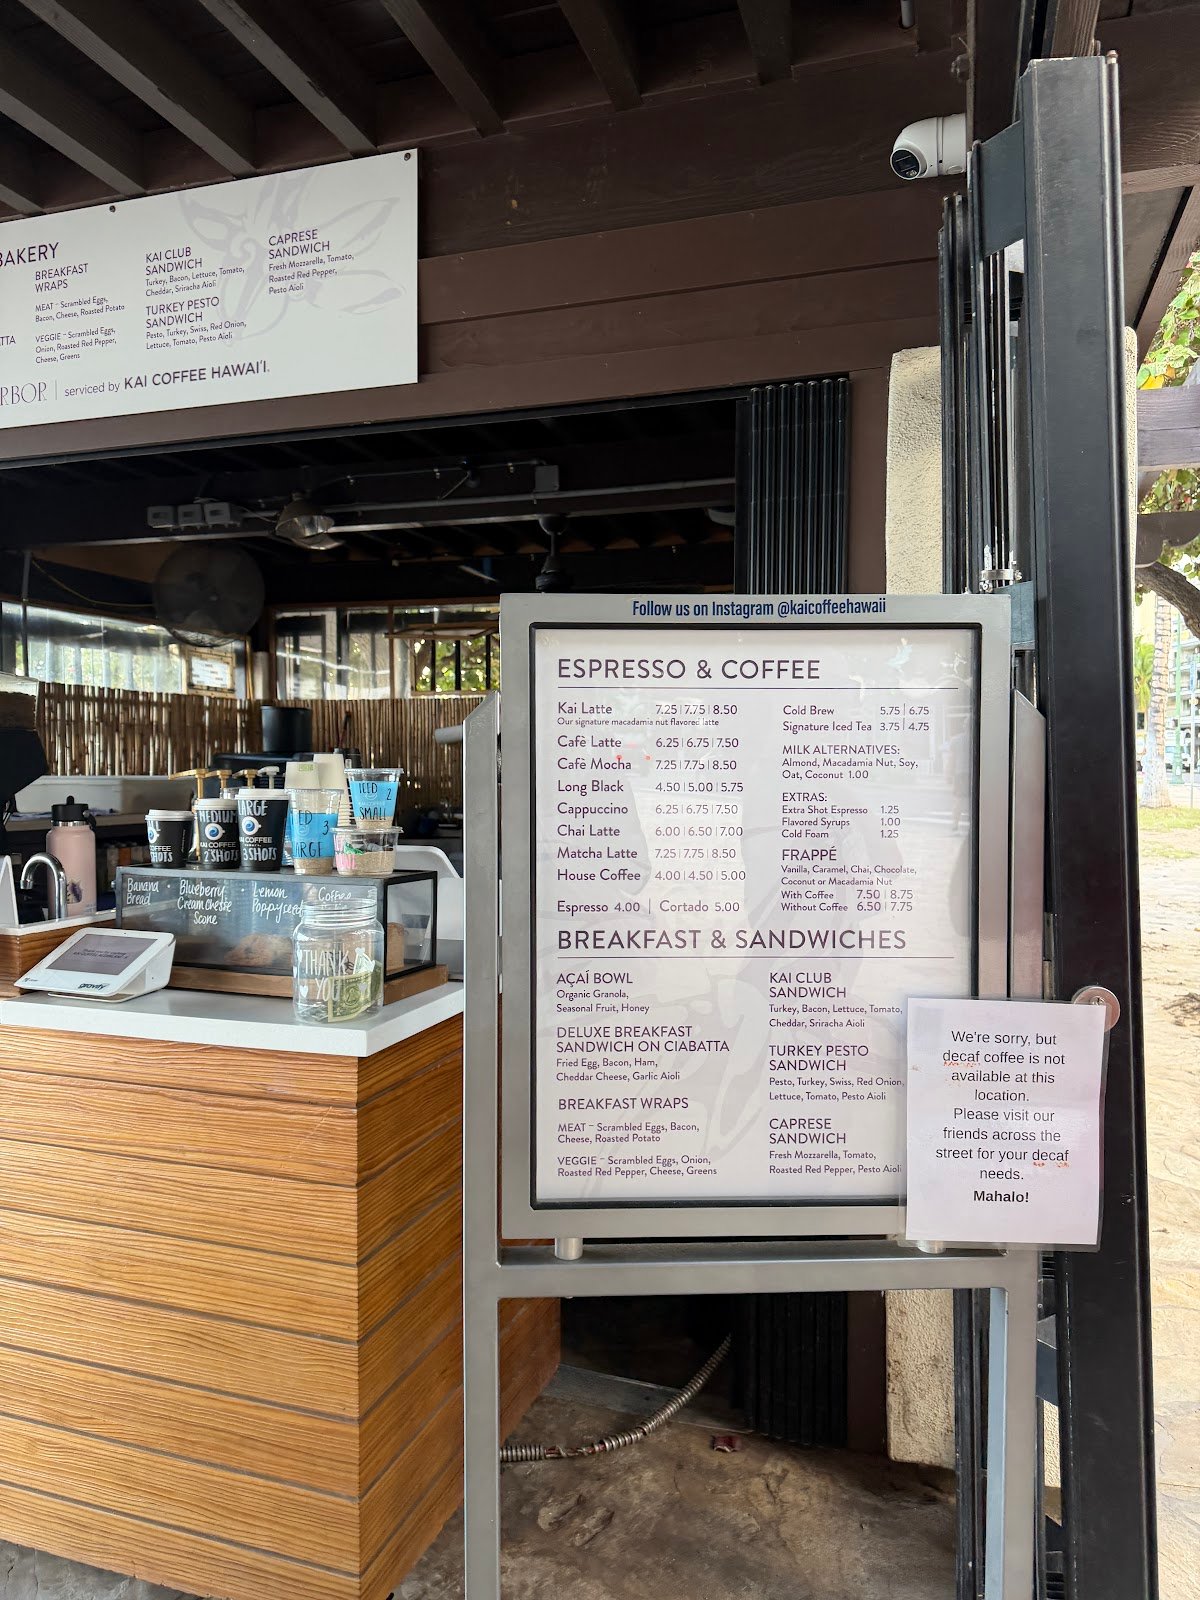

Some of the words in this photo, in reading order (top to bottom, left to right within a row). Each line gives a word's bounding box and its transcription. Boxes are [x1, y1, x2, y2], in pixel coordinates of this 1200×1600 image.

[269, 229, 318, 246] CAPRESE
[146, 252, 162, 263] KAI
[165, 247, 191, 259] CLUB
[269, 241, 330, 259] SANDWICH
[146, 258, 202, 275] SANDWICH
[269, 262, 287, 271] Fresh
[289, 257, 325, 268] Mozzarella,
[327, 254, 354, 262] Tomato,
[36, 263, 88, 280] BREAKFAST
[146, 278, 168, 286] Turkey,
[220, 267, 244, 275] Tomato,
[35, 279, 68, 292] WRAPS
[146, 287, 174, 296] Cheddar,
[175, 283, 200, 292] Sriracha
[202, 280, 216, 288] Aioli
[288, 283, 304, 291] Aioli
[146, 301, 184, 315] TURKEY
[188, 297, 219, 310] PESTO
[146, 312, 202, 328] SANDWICH
[64, 382, 105, 397] serviced
[108, 382, 120, 392] by
[125, 375, 146, 389] KAI
[152, 368, 206, 385] COFFEE
[633, 601, 672, 615] Follow
[676, 605, 690, 616] us
[693, 605, 708, 616] on
[713, 601, 773, 619] Instagram
[778, 598, 885, 618] @kaicoffeehawaii
[559, 659, 685, 679] ESPRESSO
[697, 660, 712, 679] &
[722, 660, 820, 679] COFFEE
[558, 702, 576, 714] Kai
[582, 702, 612, 714] Latte
[783, 705, 806, 715] Cold
[812, 705, 834, 715] Brew
[575, 718, 609, 728] signature
[783, 721, 829, 735] Signature
[833, 721, 852, 731] Iced
[856, 721, 871, 731] Tea
[591, 735, 621, 747] Latte
[783, 745, 810, 754] MILK
[813, 745, 900, 754] ALTERNATIVES:
[590, 758, 631, 769] Mocha
[558, 780, 587, 797] Long
[592, 780, 623, 792] Black
[783, 792, 827, 801] EXTRAS:
[238, 800, 268, 816] LARGE
[557, 802, 628, 819] Cappuccino
[782, 805, 805, 813] Extra
[808, 805, 830, 814] Shot
[831, 805, 868, 816] Espresso
[881, 806, 899, 814] 1.25
[782, 817, 818, 826] Flavored
[821, 817, 850, 829] Syrups
[881, 818, 900, 826] 1.00
[557, 824, 584, 836] Chai
[590, 824, 620, 836] Latte
[782, 829, 804, 838] Cold
[808, 829, 829, 838] Foam
[881, 830, 898, 838] 1.25
[204, 851, 209, 862] 2
[211, 850, 239, 862] SHOTS
[243, 849, 248, 861] 3
[249, 847, 277, 861] SHOTS
[557, 847, 602, 859] Matcha
[607, 847, 637, 858] Latte
[783, 846, 837, 861] FRAPPÉ
[558, 869, 596, 880] House
[600, 869, 640, 880] Coffee
[127, 878, 159, 892] Banana
[179, 880, 226, 899] Blueberry
[253, 884, 288, 899] Lemon
[126, 891, 151, 906] Bread
[558, 901, 608, 916] Espresso
[614, 902, 640, 912] 4.00
[660, 900, 708, 912] Cortado
[715, 902, 739, 912] 5.00
[193, 912, 218, 925] Scone
[559, 930, 701, 949] BREAKFAST
[711, 930, 726, 949] &
[736, 930, 905, 949] SANDWICHES
[303, 950, 349, 977] THANK
[556, 970, 589, 986] AÇAÍ
[594, 973, 633, 983] BOWL
[770, 973, 791, 983] KAI
[796, 972, 831, 983] CLUB
[315, 977, 341, 1001] YOU
[770, 987, 846, 998] SANDWICH
[557, 1027, 610, 1038] DELUXE
[615, 1026, 692, 1037] BREAKFAST
[951, 1031, 990, 1043] We're
[995, 1036, 1030, 1047] sorry,
[1036, 1033, 1056, 1045] but
[557, 1041, 633, 1053] SANDWICH
[638, 1041, 659, 1052] ON
[664, 1041, 729, 1052] CIABATTA
[769, 1045, 822, 1056] TURKEY
[826, 1045, 868, 1056] PESTO
[943, 1050, 980, 1062] decaf
[984, 1052, 1024, 1063] coffee
[1029, 1052, 1039, 1064] is
[1045, 1055, 1065, 1064] not
[770, 1060, 846, 1070] SANDWICH
[952, 1070, 1010, 1082] available
[1015, 1073, 1027, 1083] at
[1032, 1072, 1054, 1083] this
[975, 1089, 1029, 1101] location.
[559, 1098, 637, 1110] BREAKFAST
[640, 1097, 688, 1109] WRAPS
[954, 1108, 999, 1120] Please
[1003, 1109, 1029, 1121] visit
[1034, 1112, 1055, 1121] our
[770, 1118, 831, 1129] CAPRESE
[770, 1133, 846, 1144] SANDWICH
[943, 1127, 988, 1139] friends
[993, 1131, 1036, 1141] across
[1041, 1130, 1061, 1141] the
[936, 1148, 973, 1159] street
[977, 1148, 995, 1159] for
[999, 1151, 1028, 1162] your
[1032, 1149, 1069, 1161] decaf
[980, 1168, 1023, 1179] needs.
[974, 1191, 1028, 1202] Mahalo!
